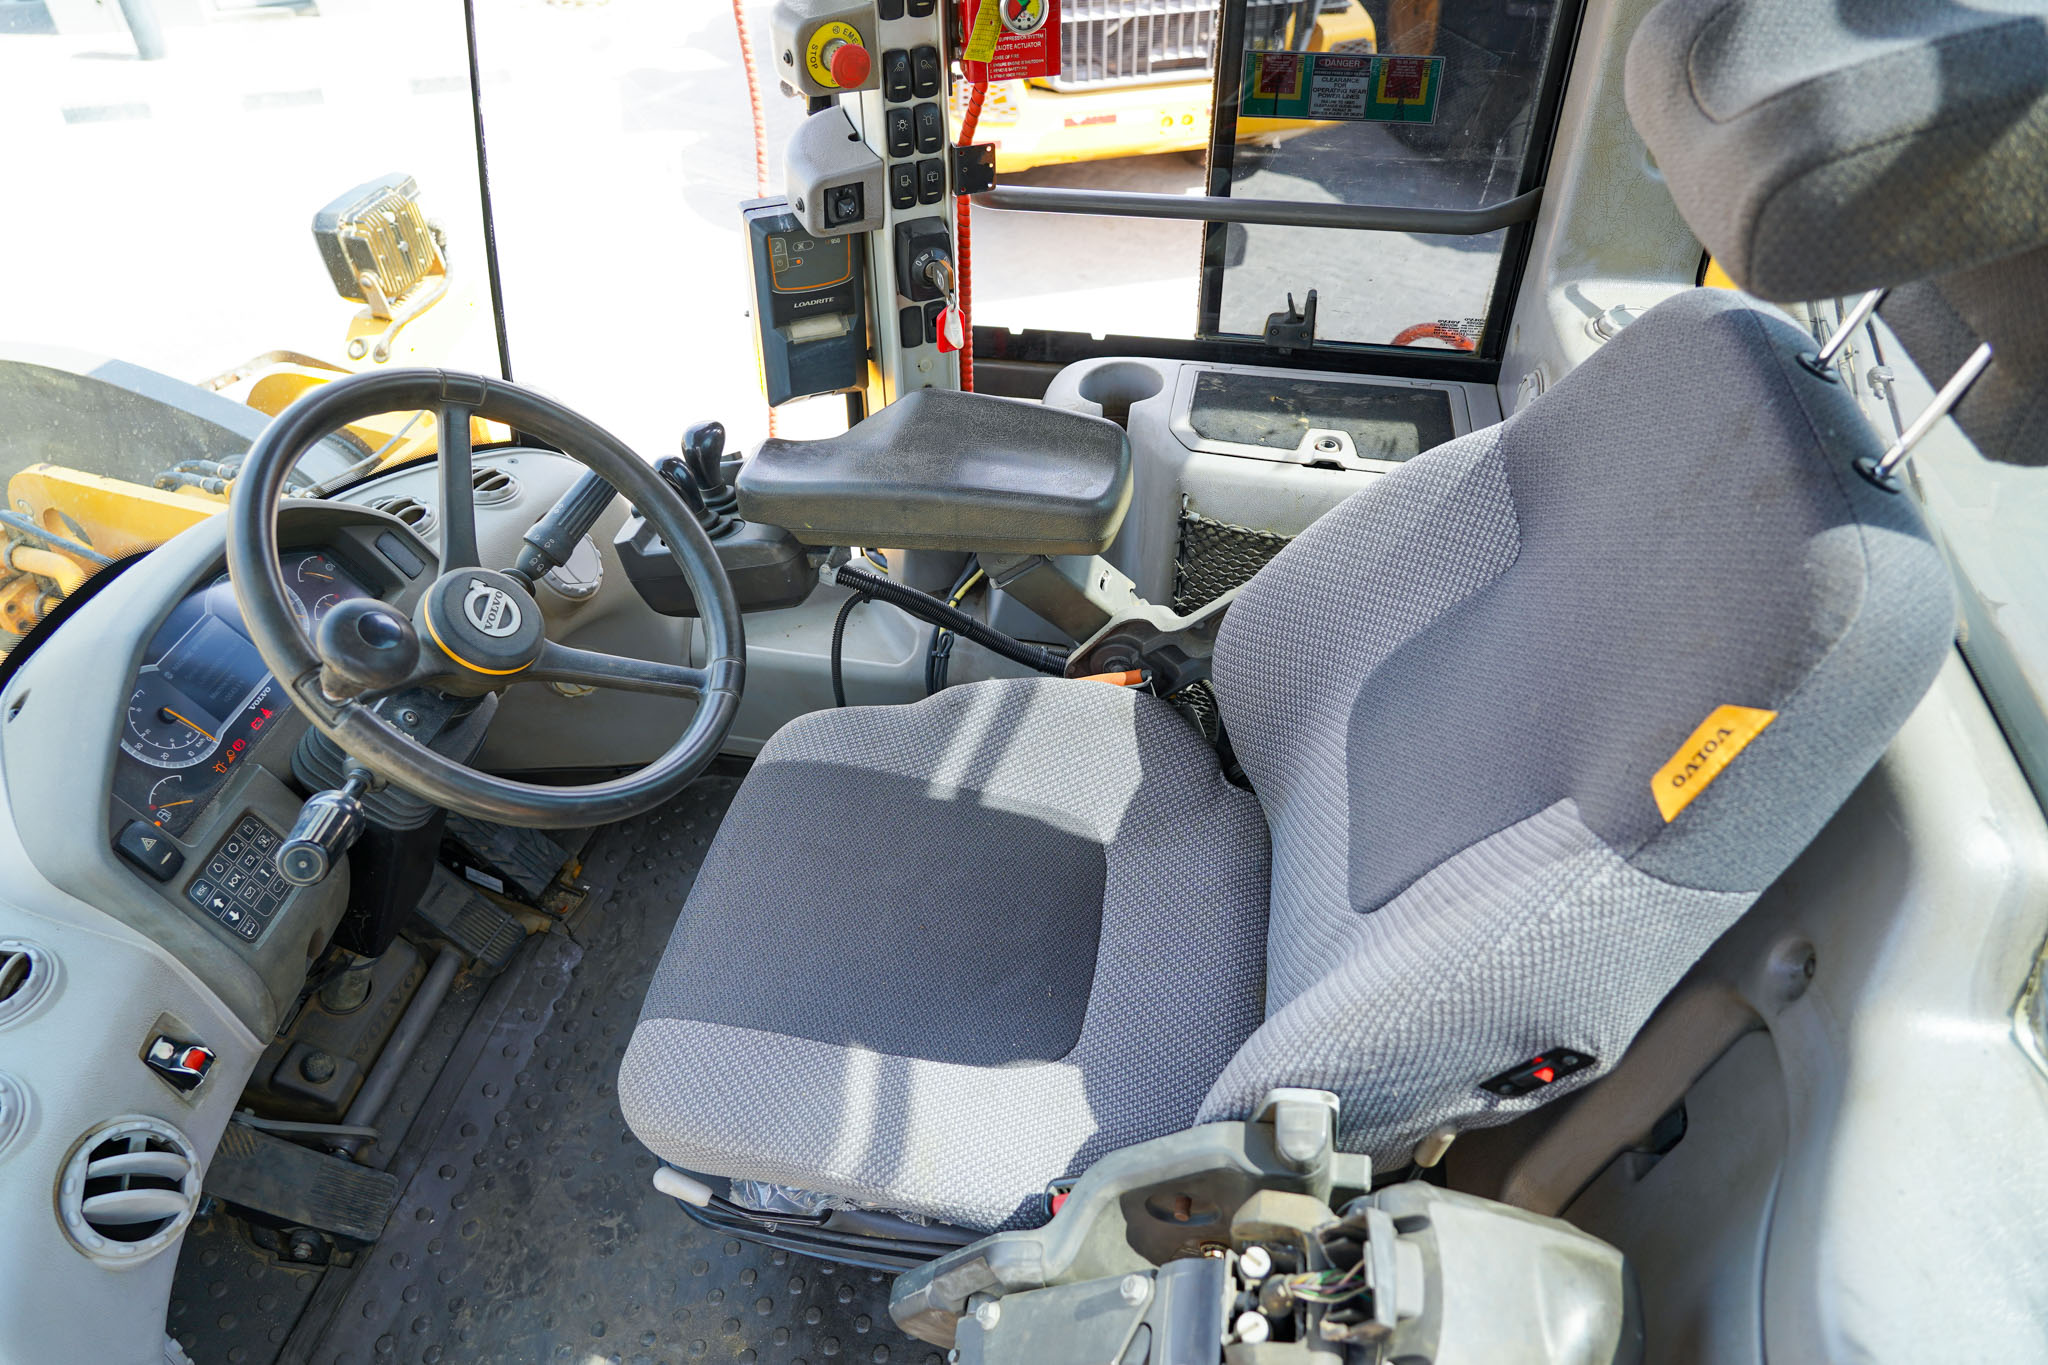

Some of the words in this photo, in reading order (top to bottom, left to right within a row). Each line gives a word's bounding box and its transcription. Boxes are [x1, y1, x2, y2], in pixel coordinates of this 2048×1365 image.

[809, 43, 819, 69] STOP
[1014, 41, 1042, 49] ACTUATOR
[1324, 59, 1361, 68] DANGER
[793, 296, 834, 309] LOADRITE
[484, 590, 504, 631] VOLVO
[248, 686, 272, 711] VOLVO
[1671, 727, 1734, 788] VOLVO
